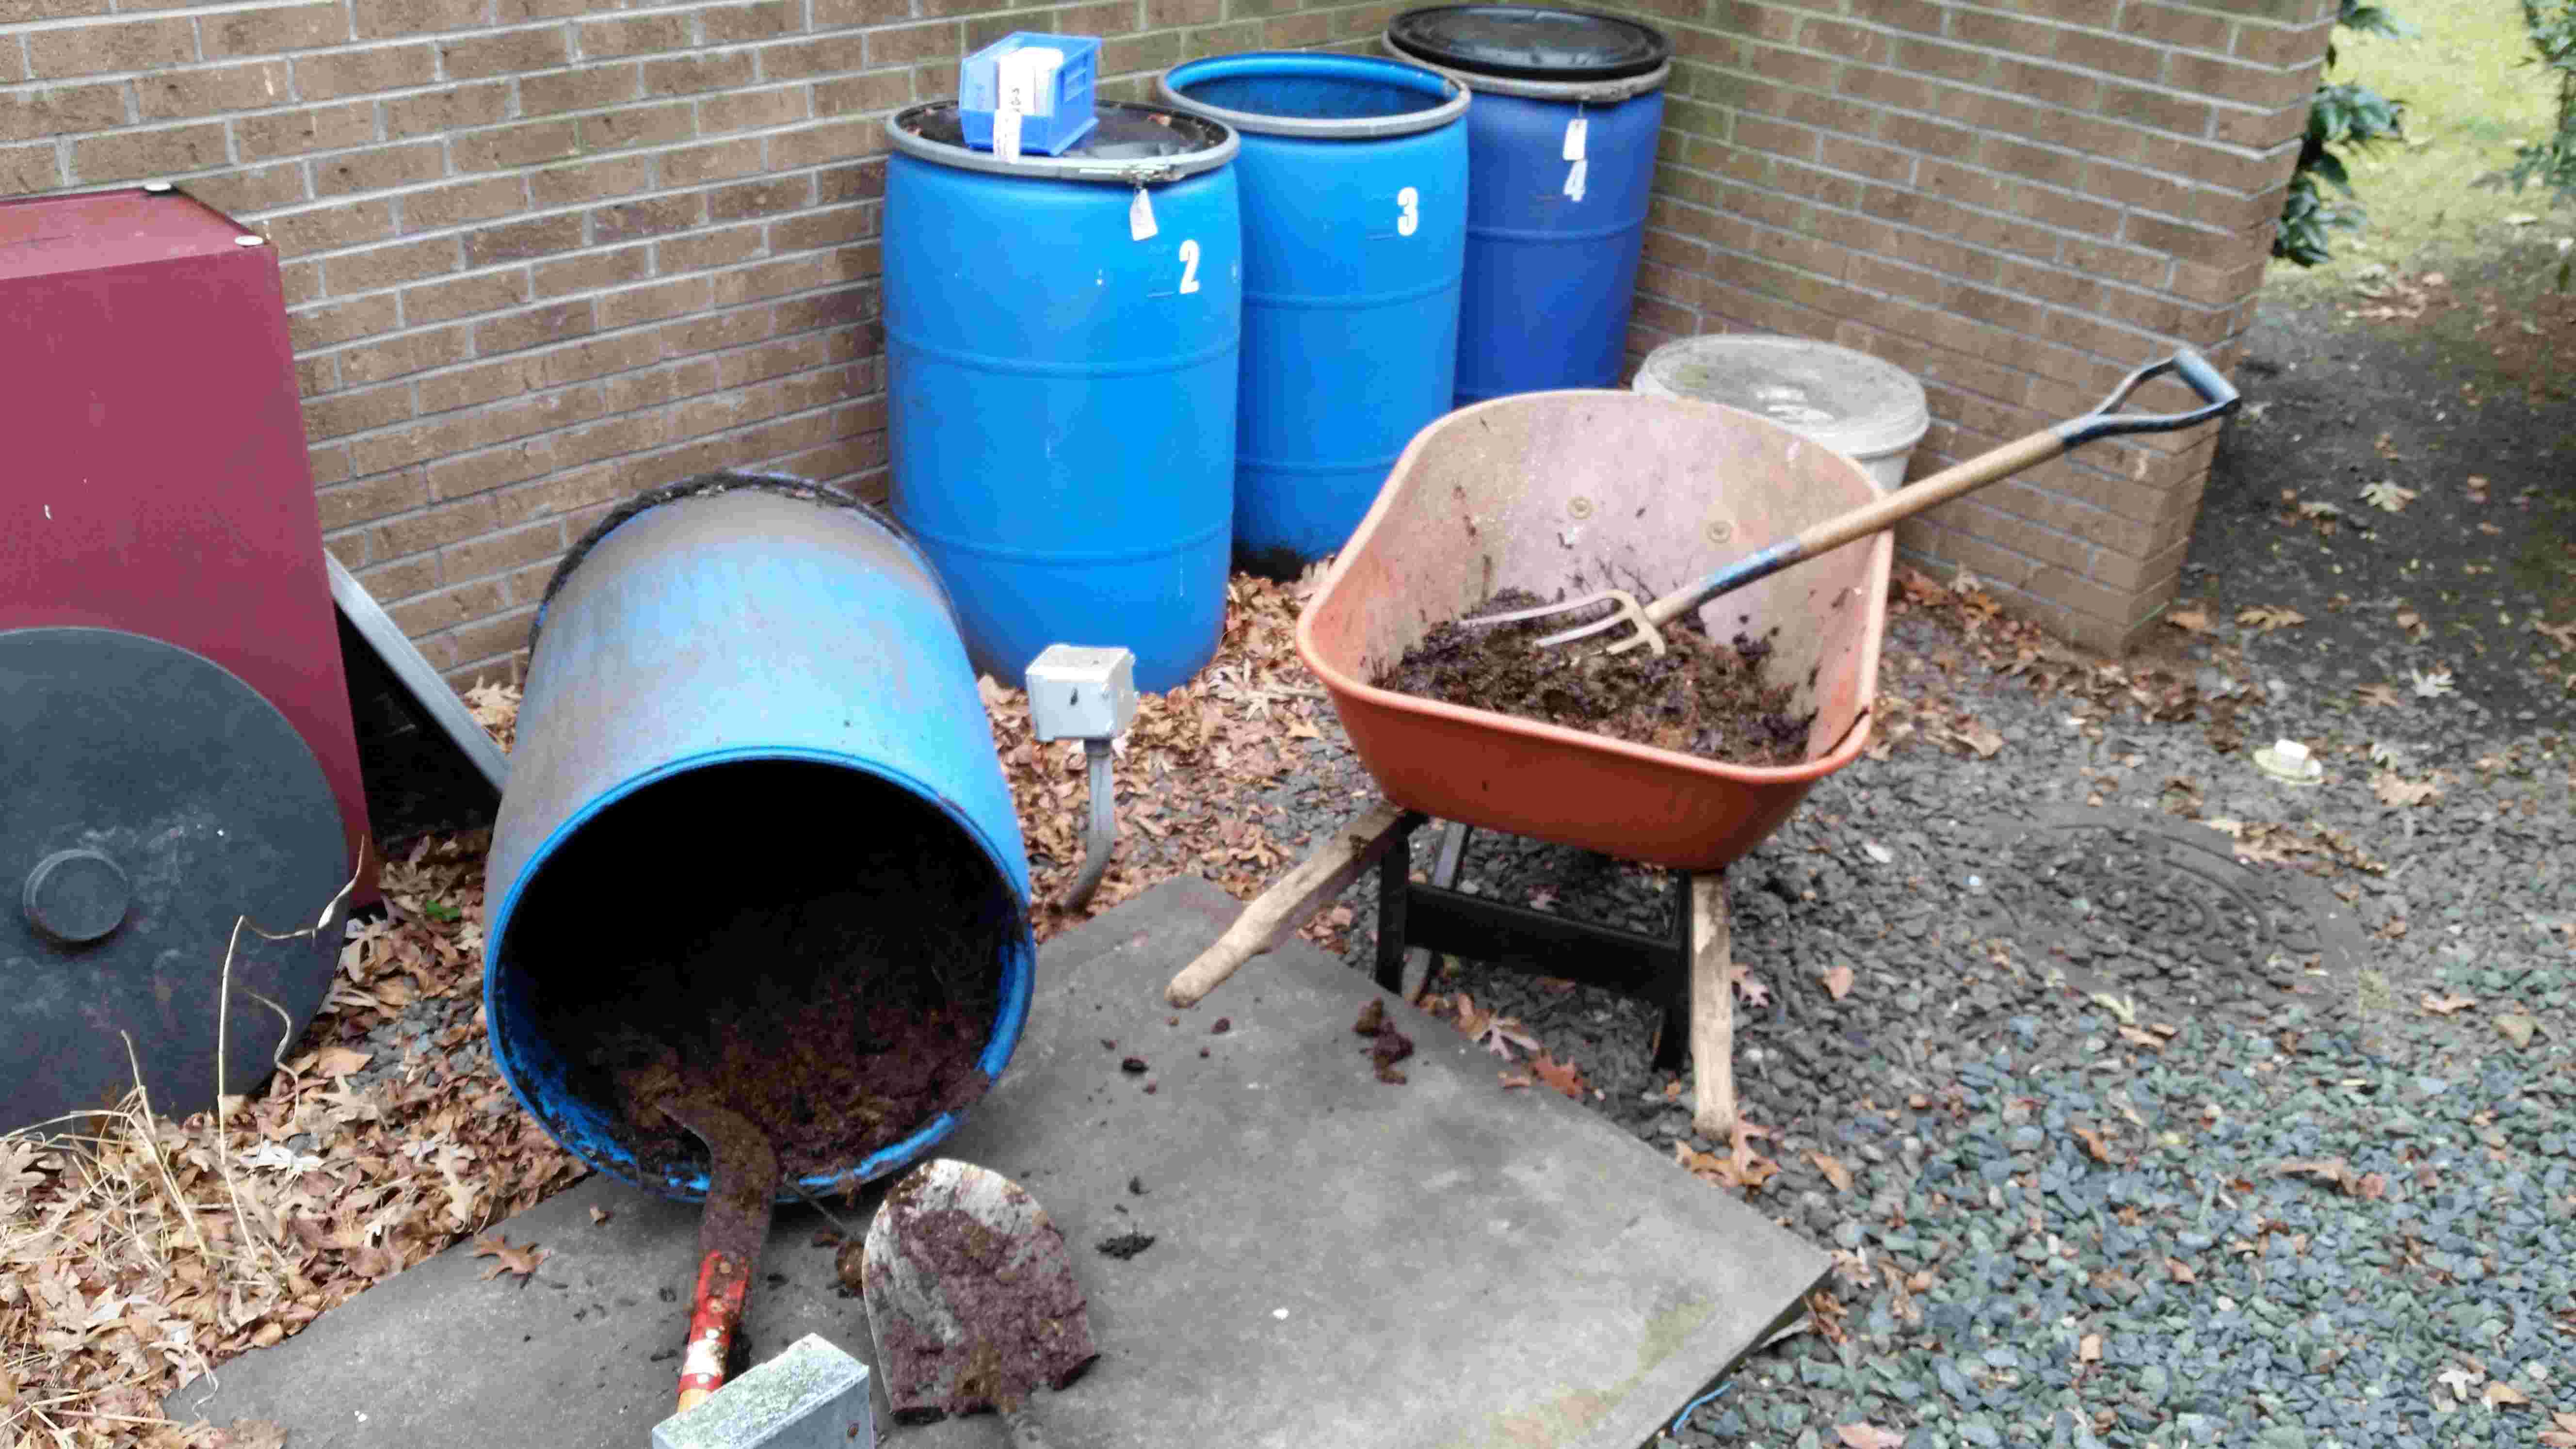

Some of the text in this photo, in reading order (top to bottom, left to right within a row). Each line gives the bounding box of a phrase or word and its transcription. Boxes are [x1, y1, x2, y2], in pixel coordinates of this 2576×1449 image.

[1563, 160, 1587, 201] 4
[1398, 187, 1418, 236] 3
[1179, 240, 1200, 294] 2
